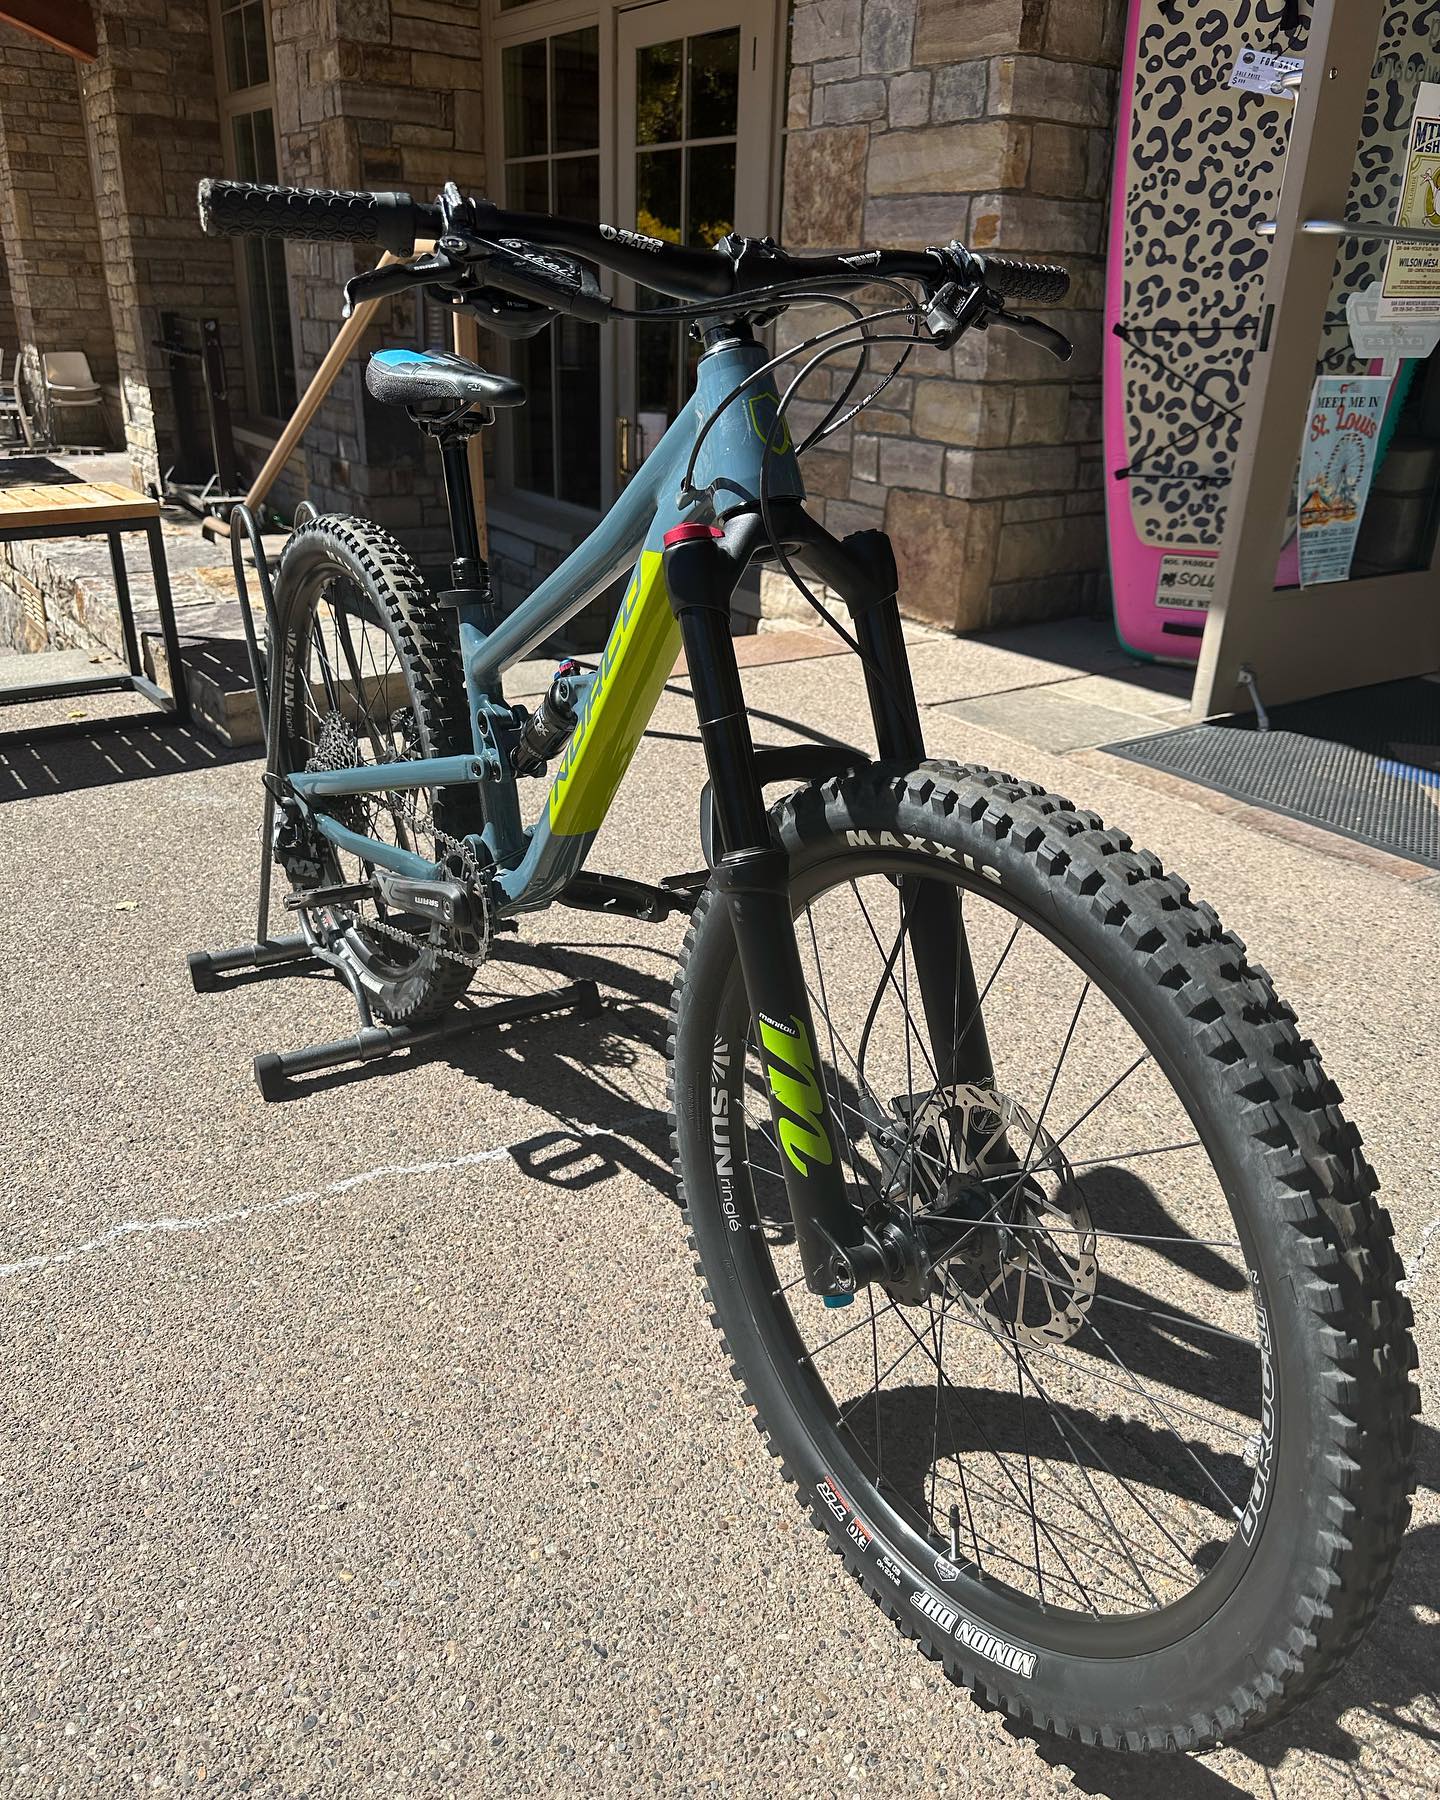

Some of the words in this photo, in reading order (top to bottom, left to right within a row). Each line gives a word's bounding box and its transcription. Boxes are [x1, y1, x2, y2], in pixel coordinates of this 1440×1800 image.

[618, 229, 664, 247] SDG
[1400, 258, 1421, 267] WILSON
[1423, 259, 1438, 267] MESA
[1318, 397, 1346, 408] MEET
[1349, 397, 1366, 408] ME
[1311, 414, 1330, 442] St.
[1336, 405, 1377, 439] Louis
[284, 654, 296, 707] SUN
[845, 829, 1003, 885] MAXXIS
[414, 896, 440, 908] SRAM
[758, 1011, 796, 1035] manitou
[711, 1086, 734, 1176] SUN
[815, 1481, 847, 1522] TR
[847, 1521, 869, 1551] EXO
[909, 1590, 959, 1634] DHF
[954, 1620, 1038, 1679] MINION
